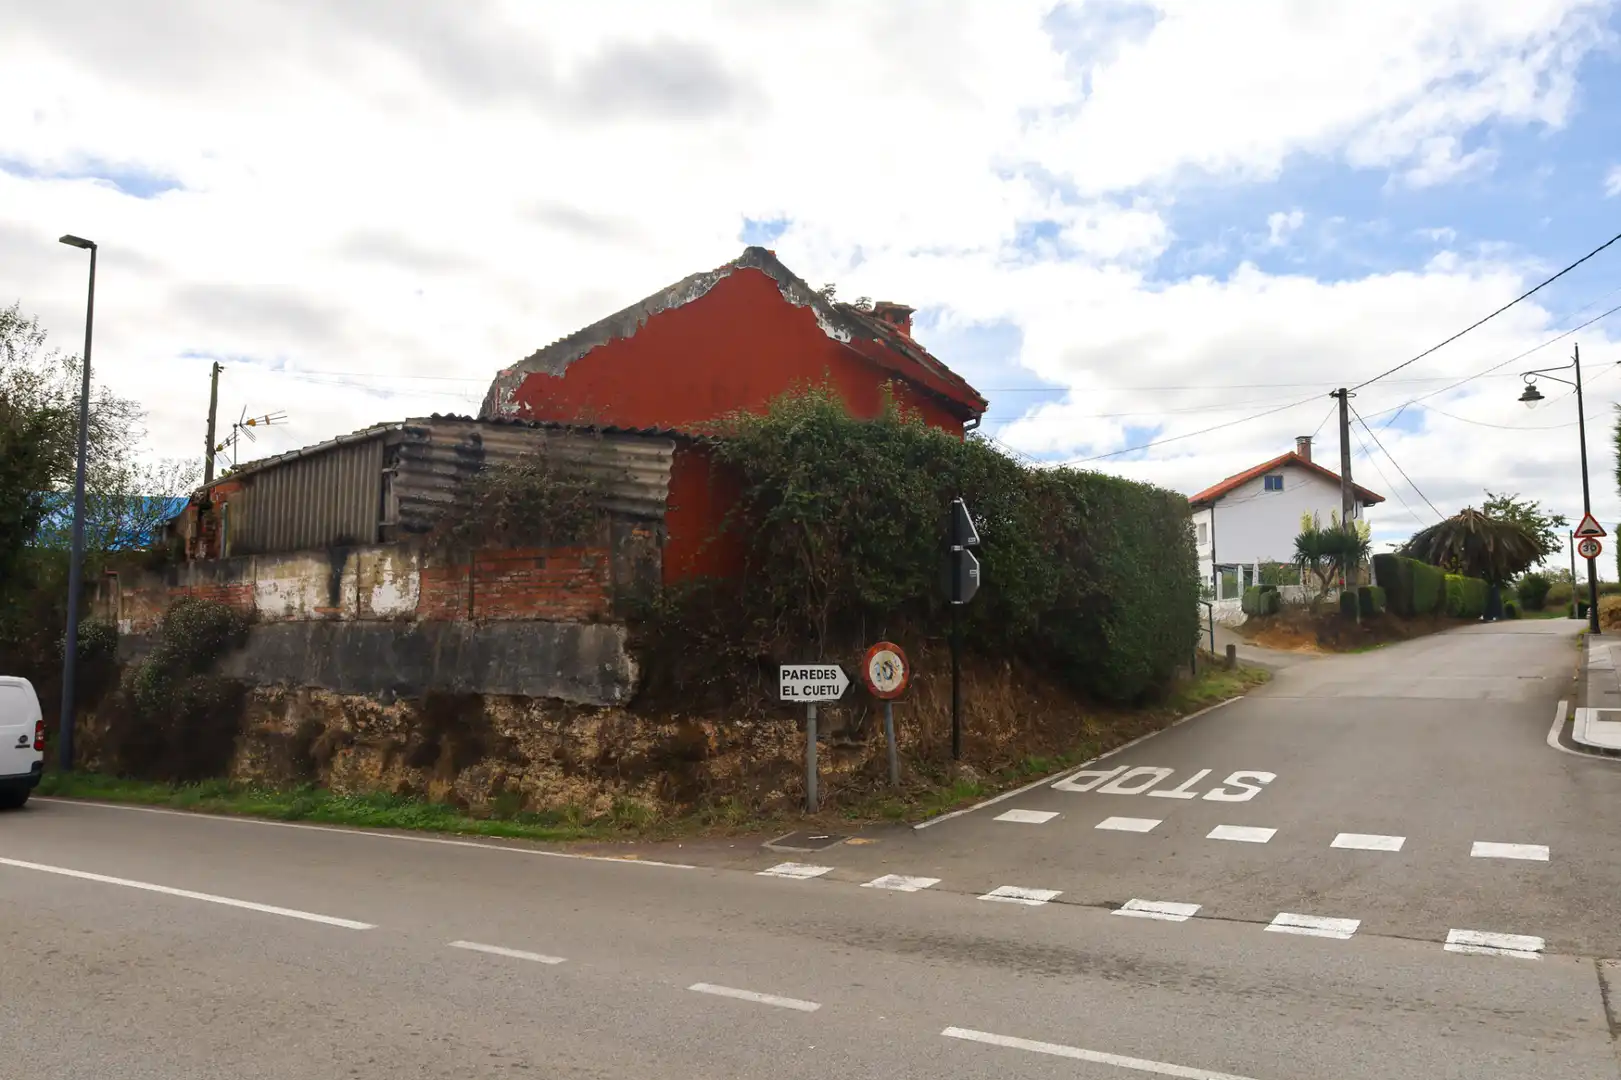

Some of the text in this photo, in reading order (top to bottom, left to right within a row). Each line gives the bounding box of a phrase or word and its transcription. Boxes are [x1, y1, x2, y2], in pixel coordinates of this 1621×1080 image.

[1582, 544, 1597, 552] 30
[782, 669, 837, 680] PAREDES
[782, 685, 840, 696] EL CUETU
[1050, 765, 1278, 802] STOP
